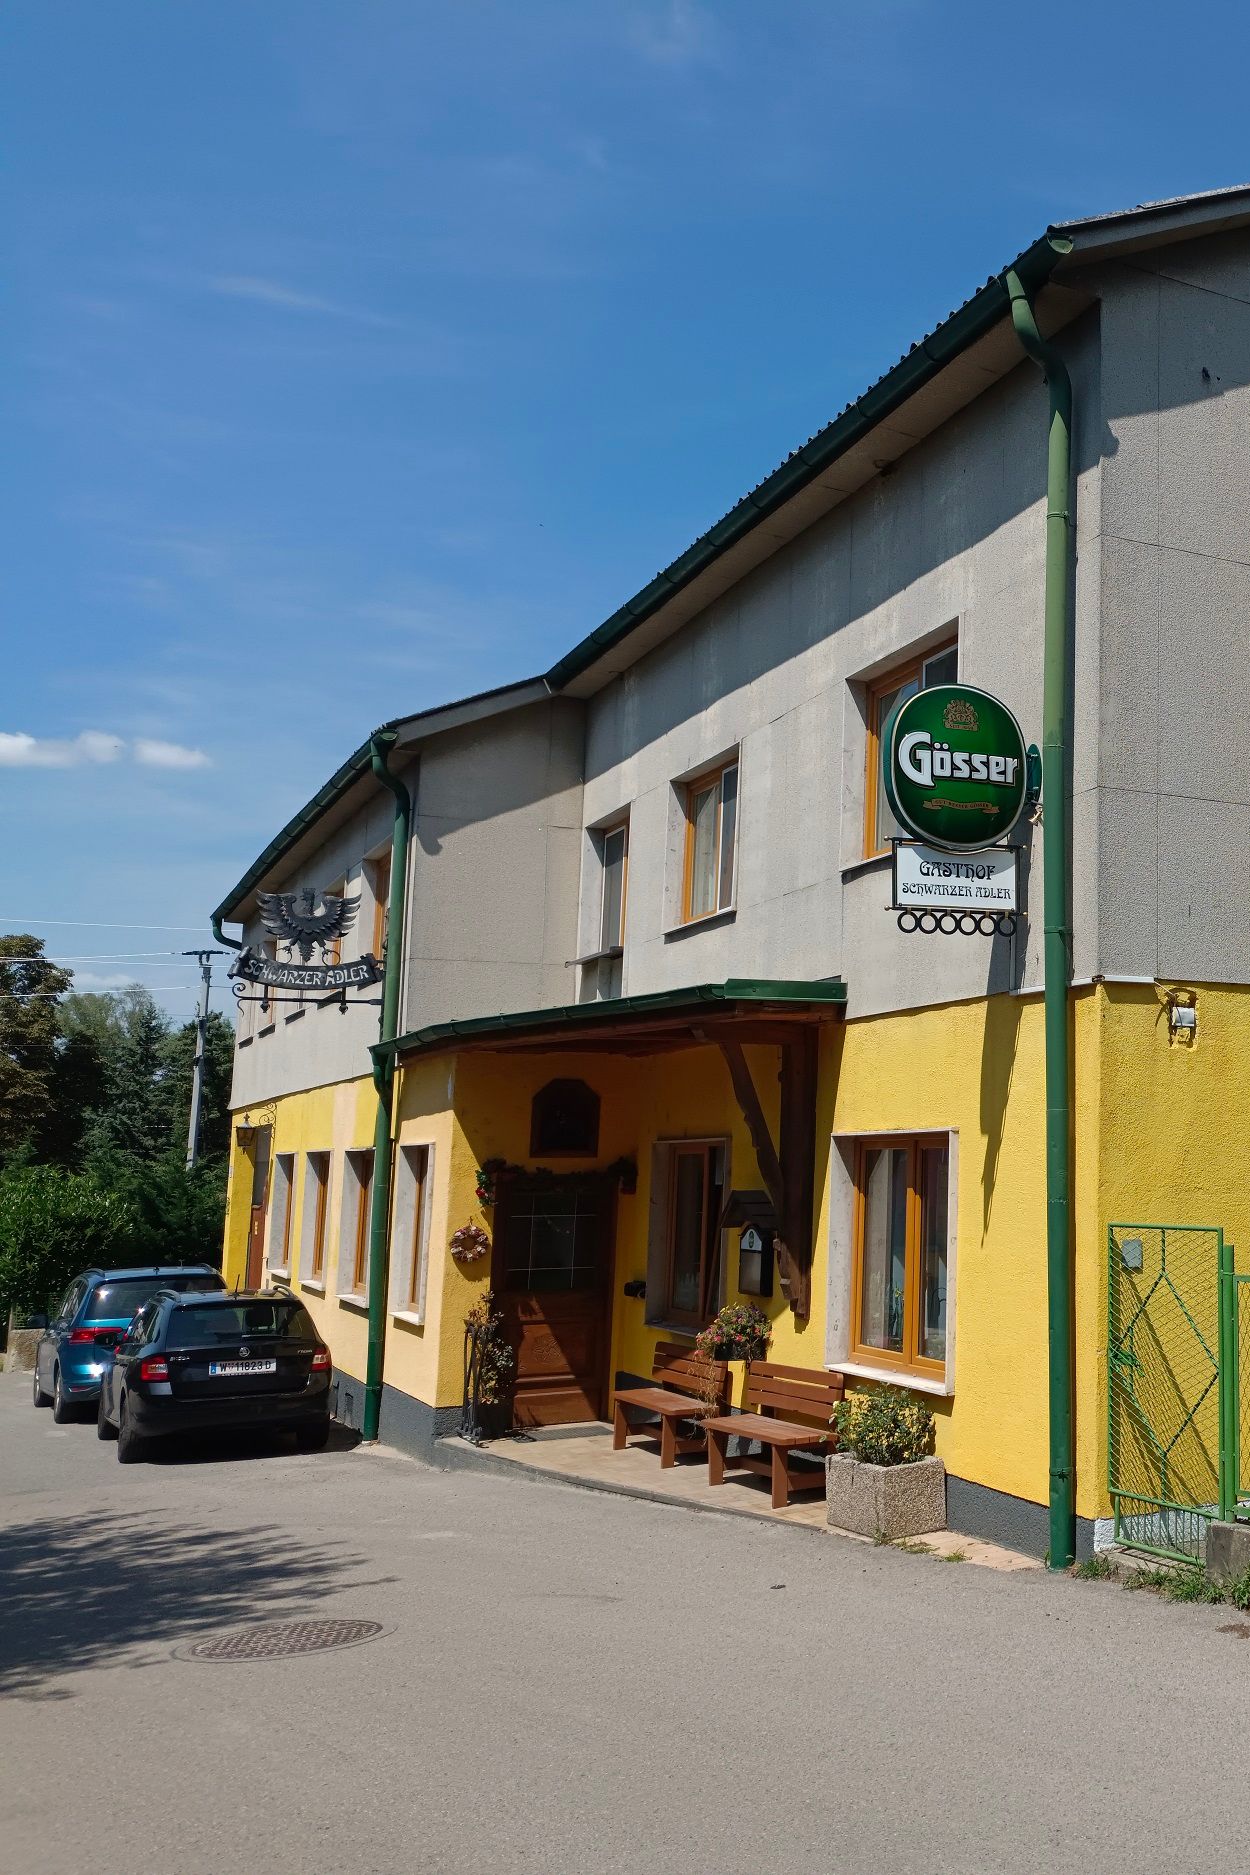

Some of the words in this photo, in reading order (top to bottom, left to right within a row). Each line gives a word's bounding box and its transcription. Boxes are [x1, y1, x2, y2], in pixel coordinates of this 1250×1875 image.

[899, 731, 1018, 786] Gösser
[920, 861, 995, 882] GASTHOF
[902, 882, 972, 897] SCHWARZER
[975, 886, 1012, 899] ADLER
[244, 959, 321, 985] SCHWARZER
[325, 965, 369, 986] ADLER
